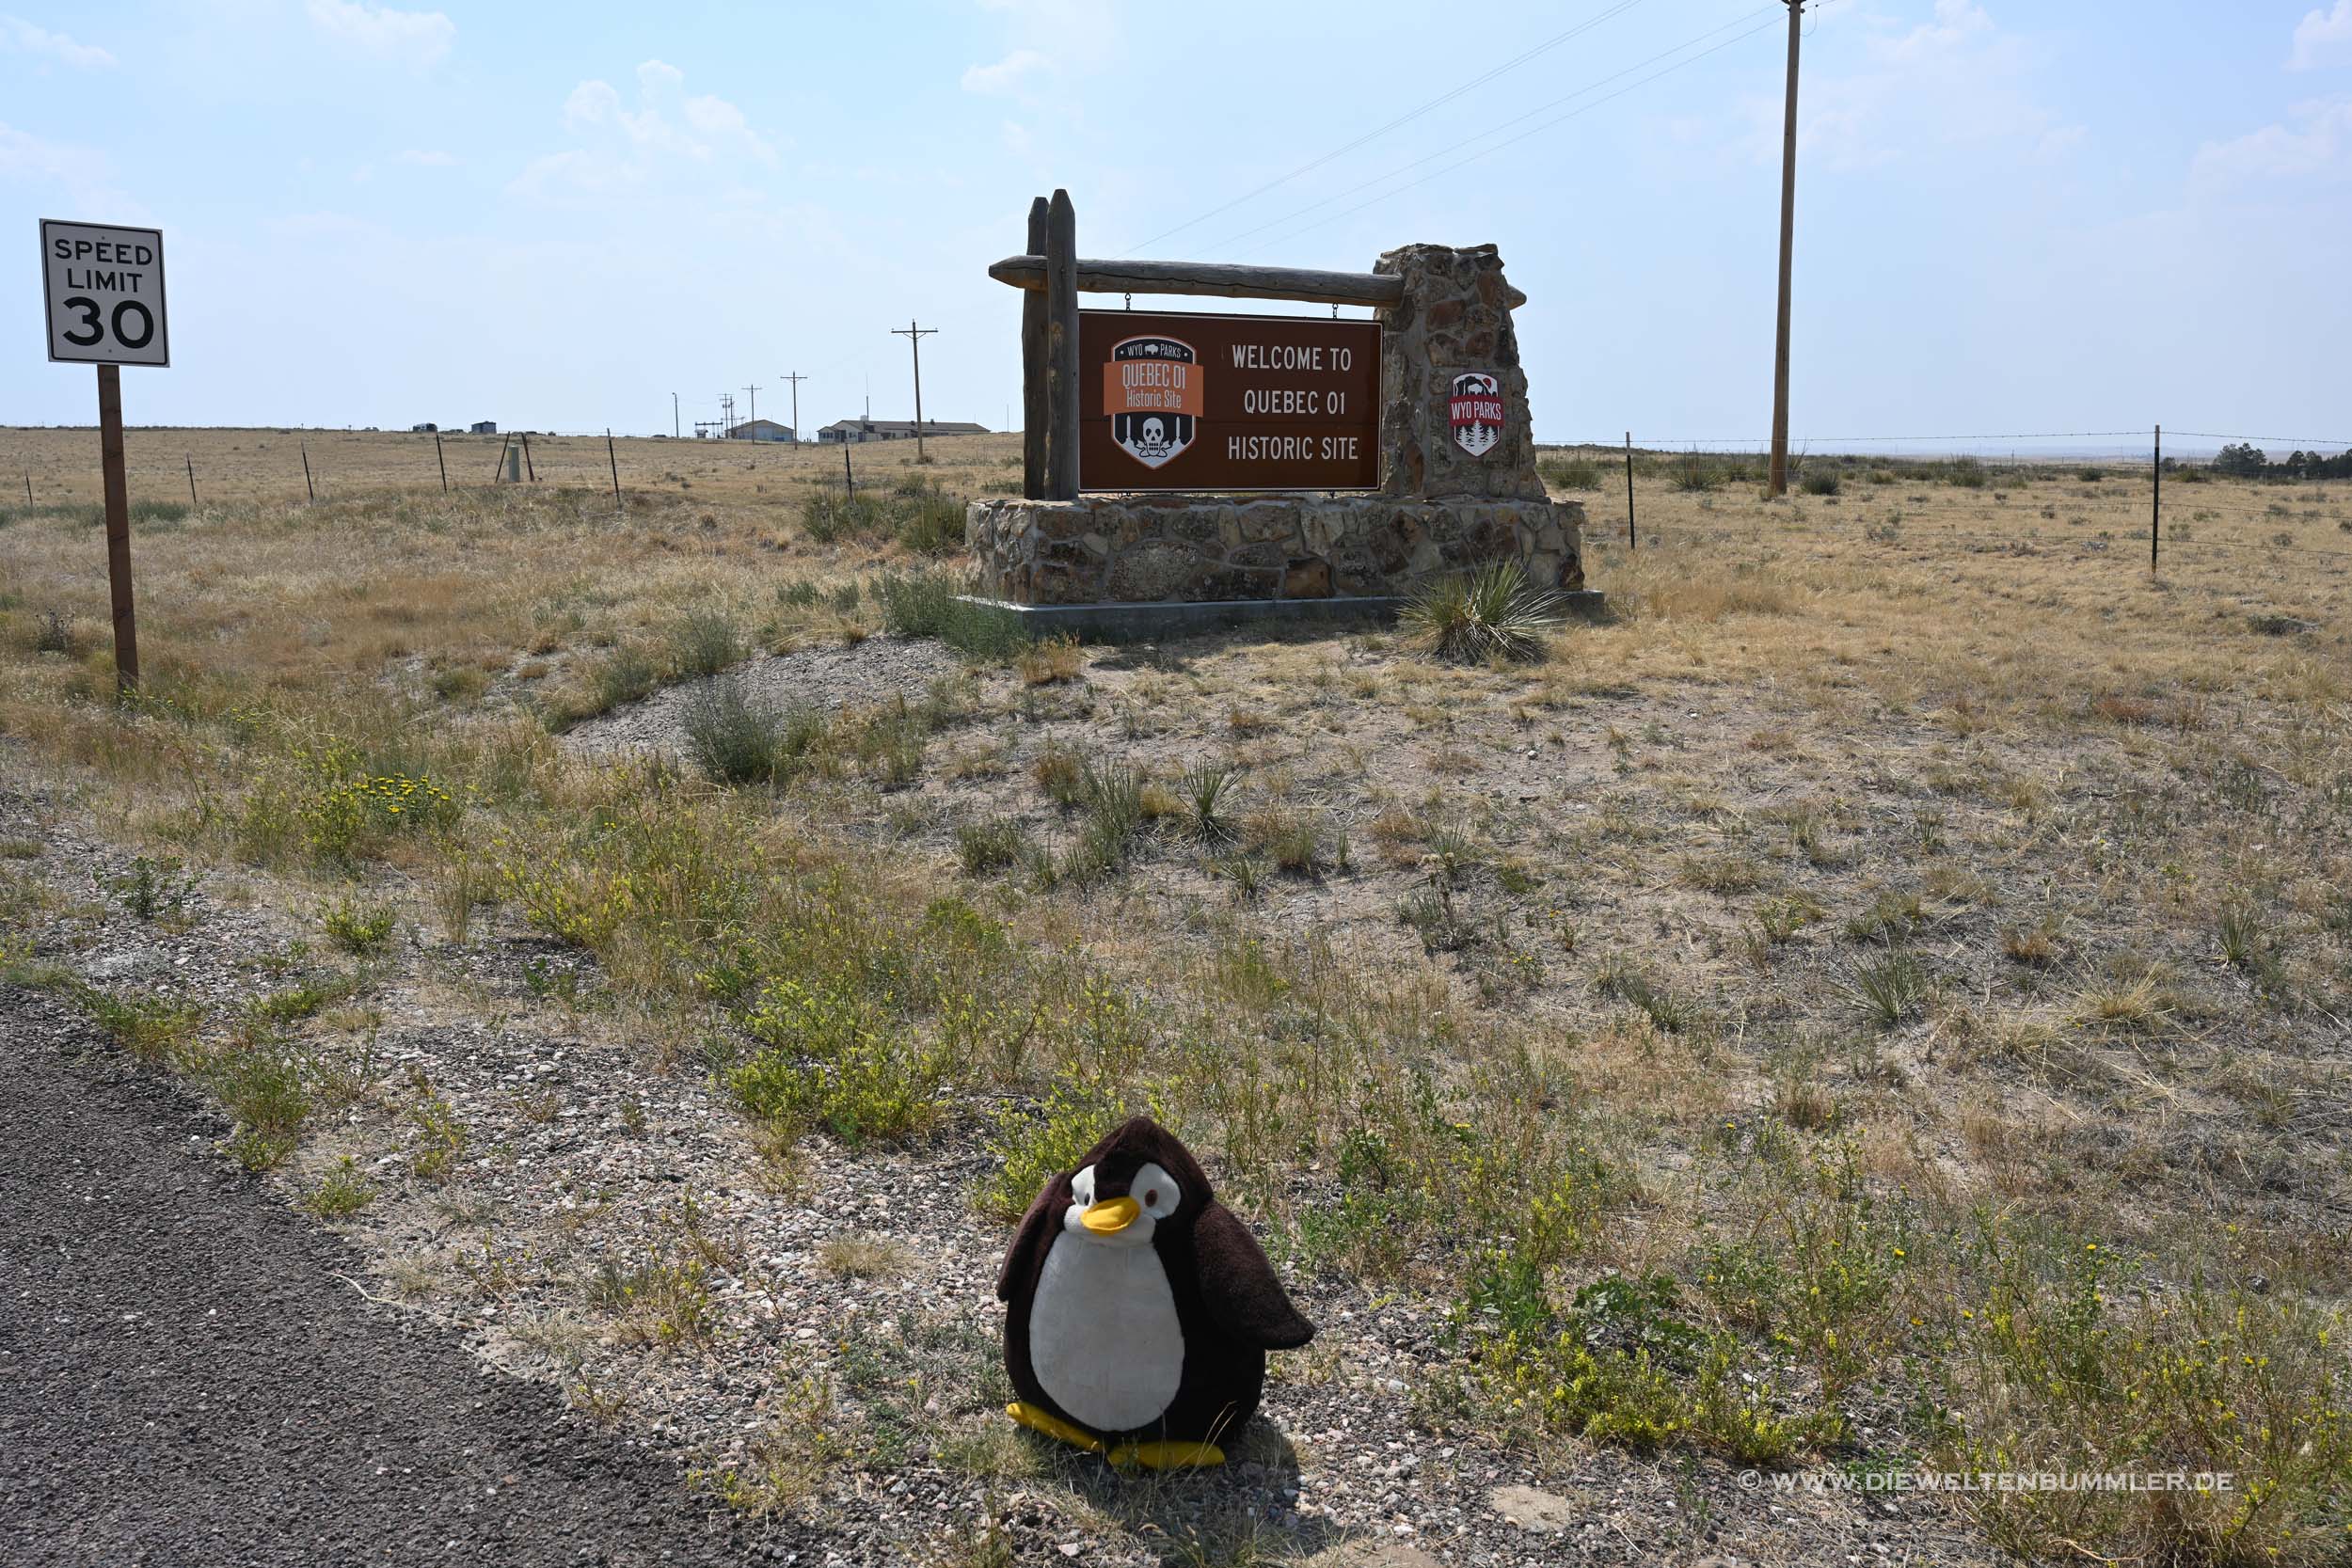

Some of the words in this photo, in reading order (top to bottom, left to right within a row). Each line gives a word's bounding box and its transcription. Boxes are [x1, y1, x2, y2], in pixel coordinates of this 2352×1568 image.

[55, 238, 152, 265] SPEED
[68, 268, 142, 293] LIMIT
[63, 296, 154, 349] 30
[1127, 343, 1143, 356] WYO
[1160, 343, 1182, 358] PARKS
[1232, 344, 1323, 371] WELCOME
[1329, 347, 1352, 372] TO
[1122, 363, 1169, 389] QUEBEC
[1173, 364, 1186, 389] 01
[1126, 388, 1162, 407] Historic
[1164, 389, 1182, 409] Site
[1244, 389, 1318, 414] QUEBEC
[1327, 391, 1345, 415] 01
[1451, 401, 1471, 420] WYO
[1473, 401, 1502, 420] PARKS
[1228, 436, 1313, 460] HISTORIC
[1321, 436, 1359, 460] SITE
